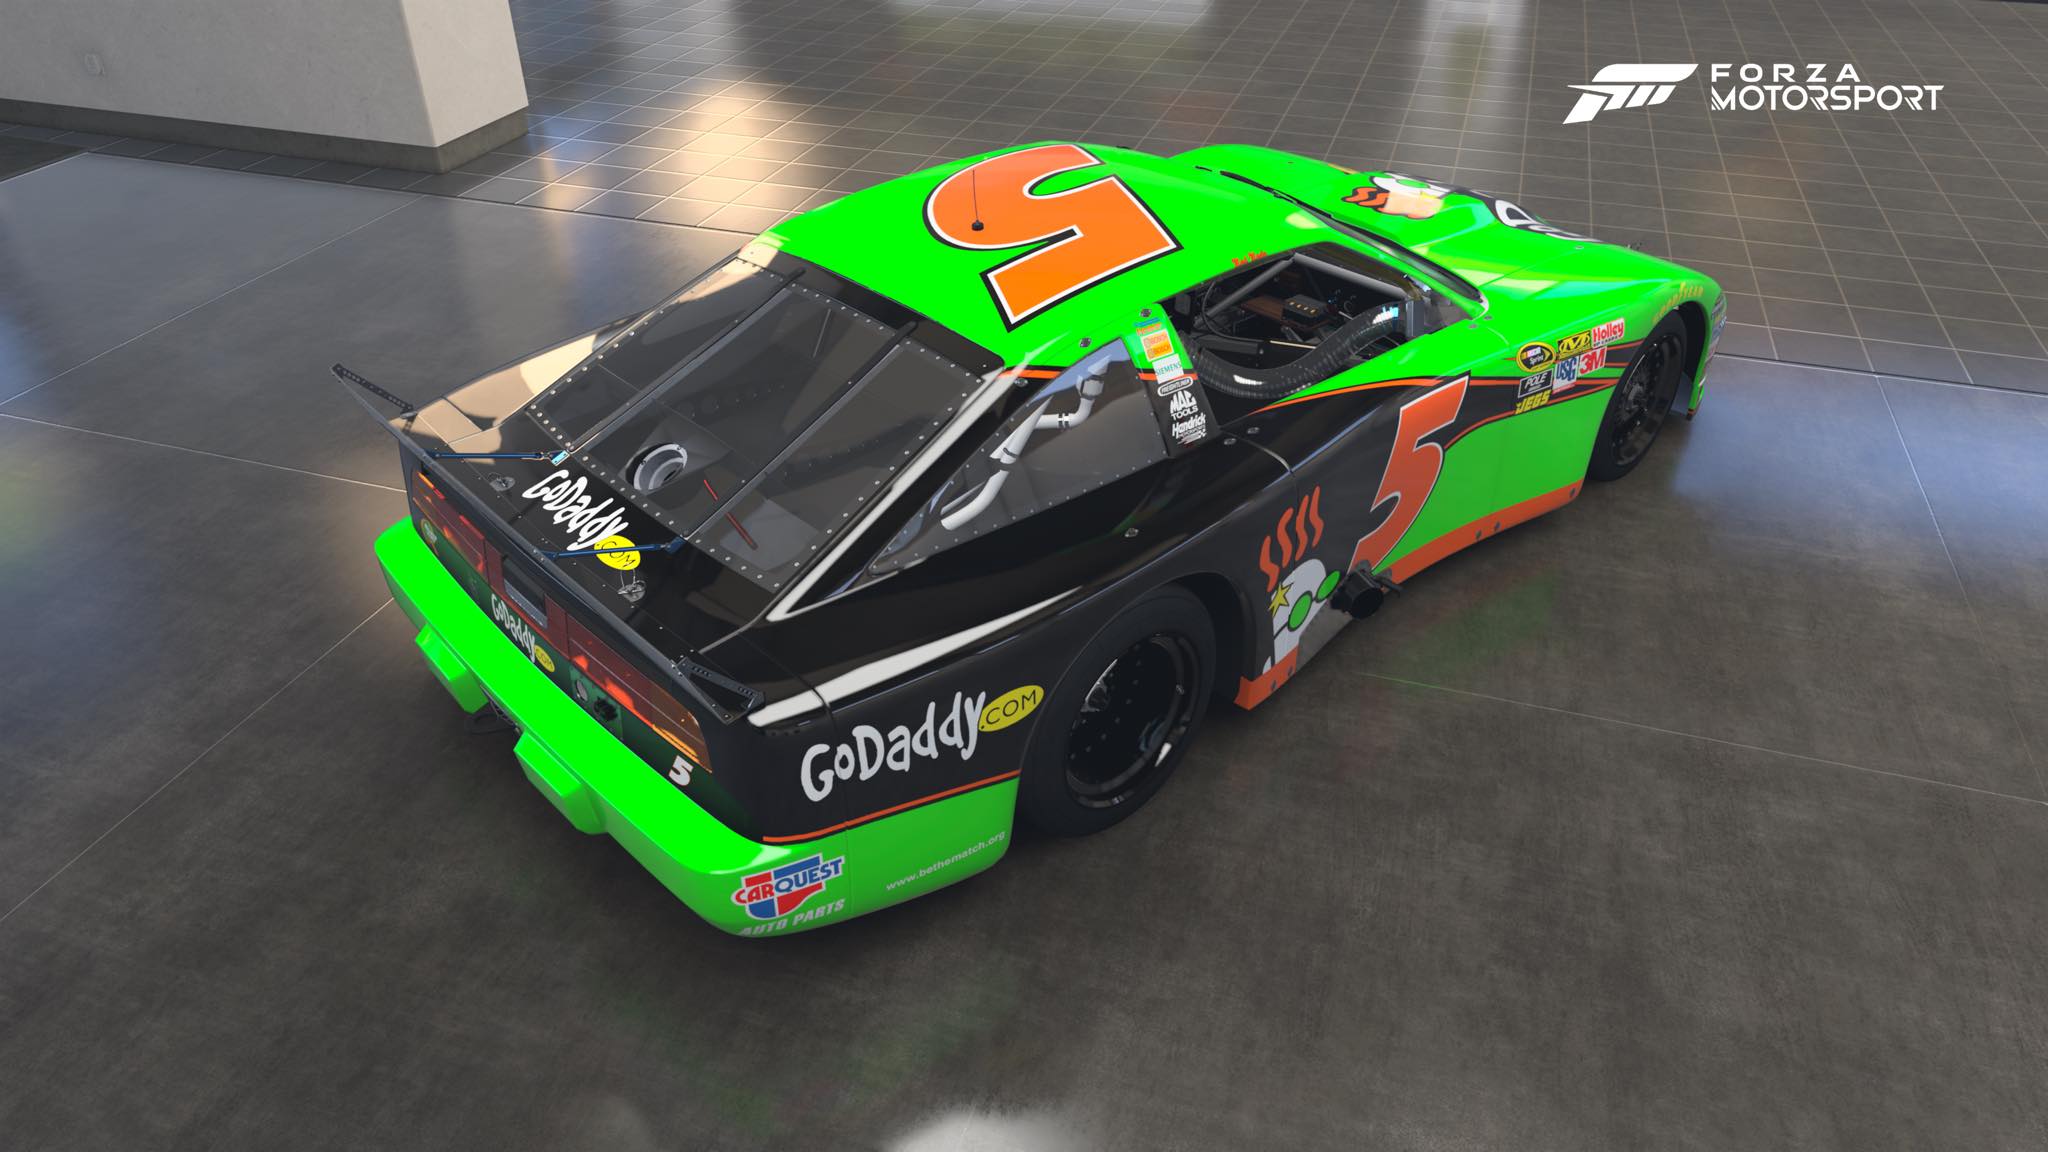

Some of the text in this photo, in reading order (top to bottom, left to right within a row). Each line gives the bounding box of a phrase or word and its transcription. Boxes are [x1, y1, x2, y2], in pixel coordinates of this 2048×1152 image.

[922, 144, 1184, 333] 5
[1580, 348, 1606, 375] 3M
[1170, 390, 1197, 415] MAC
[1171, 405, 1199, 421] TOOLS
[1346, 375, 1469, 574] 5
[668, 754, 694, 786] 5
[886, 830, 1006, 891] www.bethematch.org
[734, 857, 843, 905] CARQUEST
[792, 900, 844, 926] PARTS
